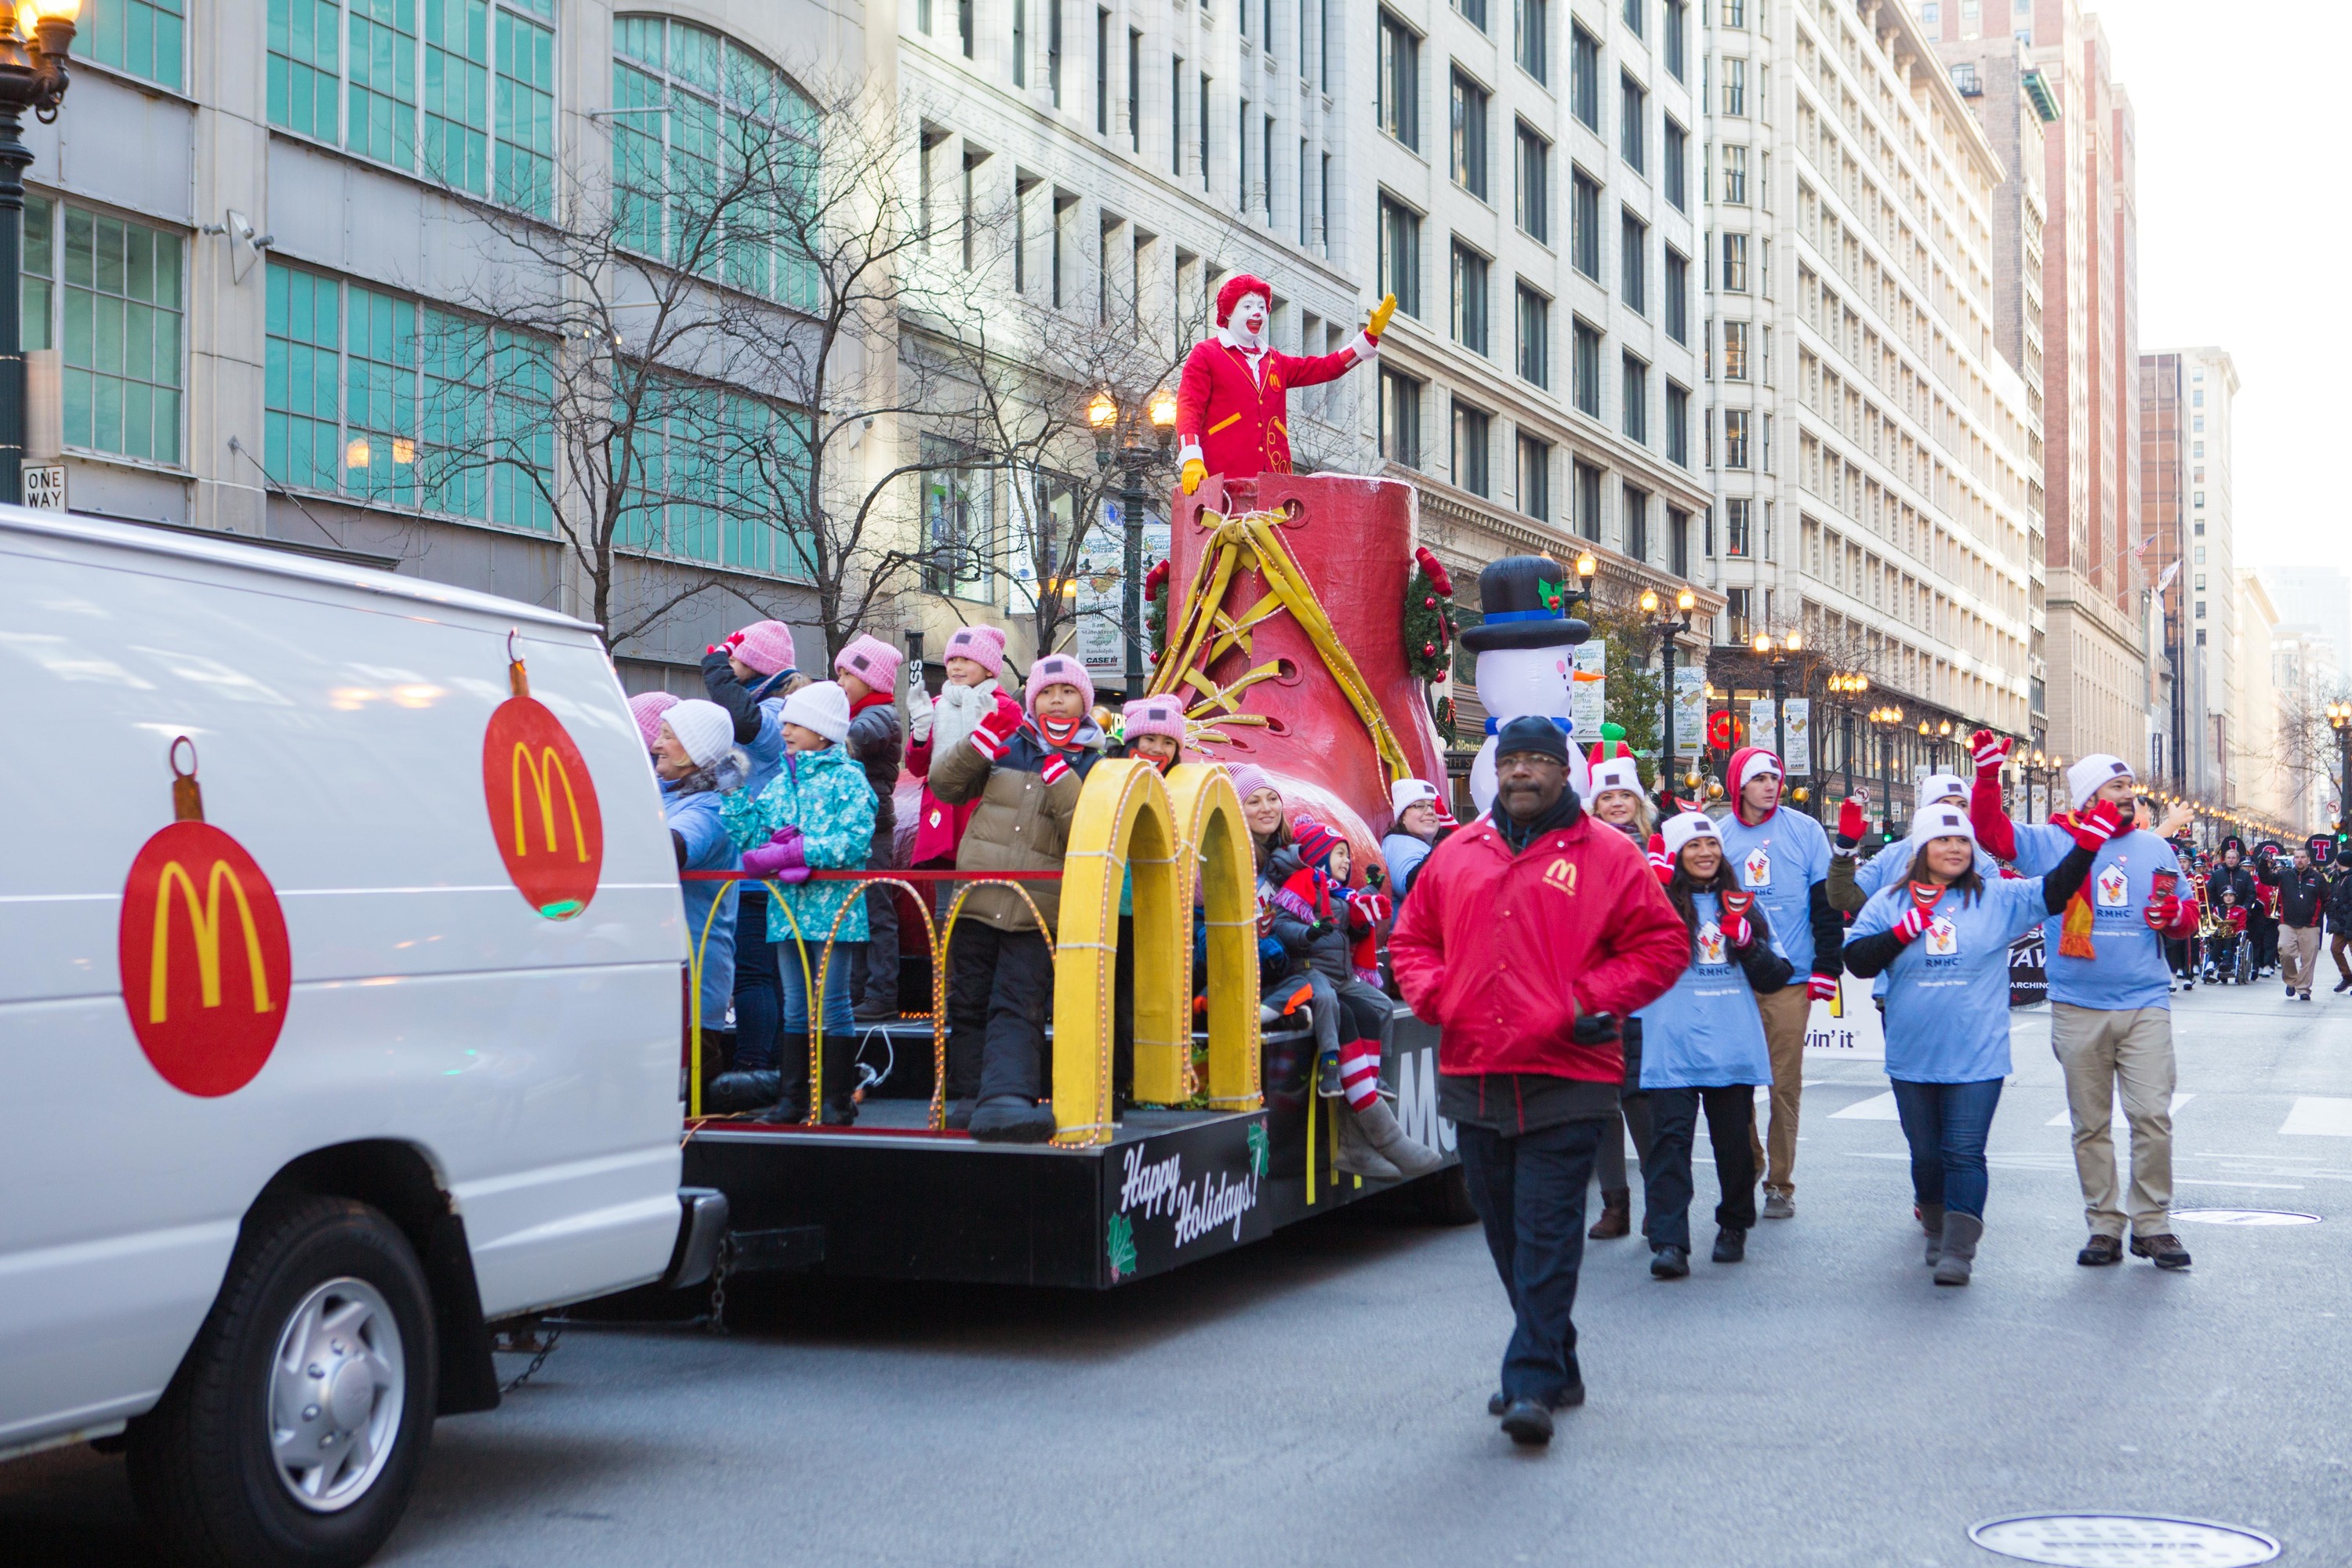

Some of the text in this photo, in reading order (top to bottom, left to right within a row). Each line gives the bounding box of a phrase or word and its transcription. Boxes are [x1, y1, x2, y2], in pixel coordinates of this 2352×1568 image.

[29, 472, 60, 488] ONE
[28, 491, 61, 508] WAY
[2312, 840, 2331, 861] T
[2096, 909, 2130, 918] RMHC
[1926, 958, 1959, 968] RMHC
[1698, 967, 1731, 977] RMHC
[1840, 1029, 1853, 1048] it
[1121, 1142, 1181, 1220] Happy
[1174, 1146, 1262, 1248] Holidays!
